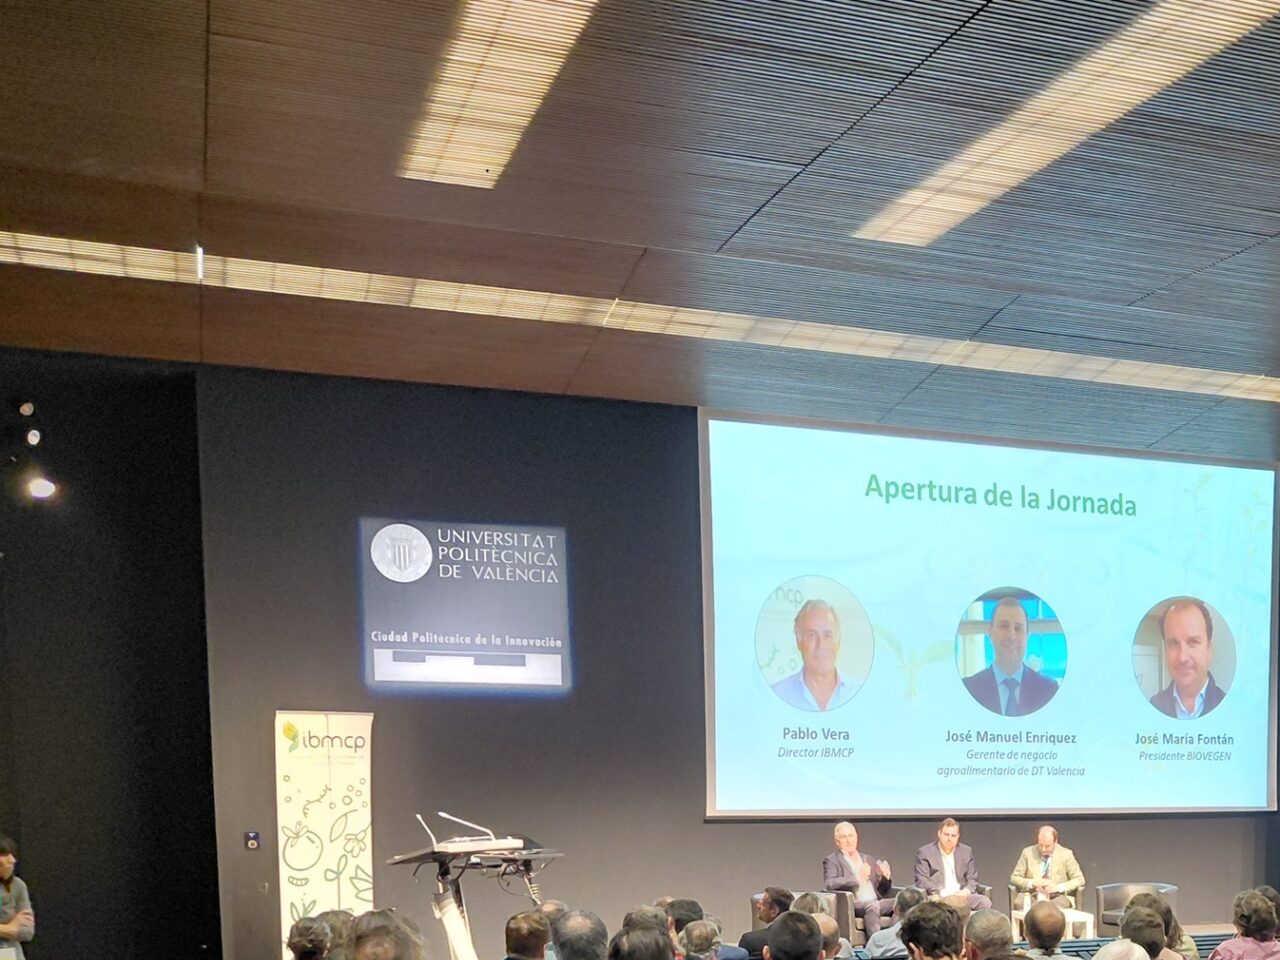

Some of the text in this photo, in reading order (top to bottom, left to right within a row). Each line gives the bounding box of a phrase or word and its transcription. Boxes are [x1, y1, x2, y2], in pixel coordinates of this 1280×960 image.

[865, 474, 1136, 516] Apertura de la Jornada
[438, 529, 556, 548] UNIVERSITAT
[438, 546, 558, 566] POLITÈCNICA
[440, 564, 558, 583] DE VALÈNCIA
[371, 631, 408, 642] Ciudad
[475, 634, 487, 645] de
[492, 634, 501, 645] la
[506, 635, 562, 647] Innovación
[783, 727, 850, 740] Pablo Vera
[945, 729, 972, 742] José
[976, 730, 1022, 743] Manuel
[1135, 732, 1234, 745] José María Fontán
[302, 730, 365, 753] ibmcp
[778, 747, 854, 758] Director IBMCP
[966, 749, 1058, 762] Gerente de negocio
[1139, 751, 1232, 761] Presidente BIOVEGEN
[937, 765, 1085, 777] agroalimentario de DT Valencia
